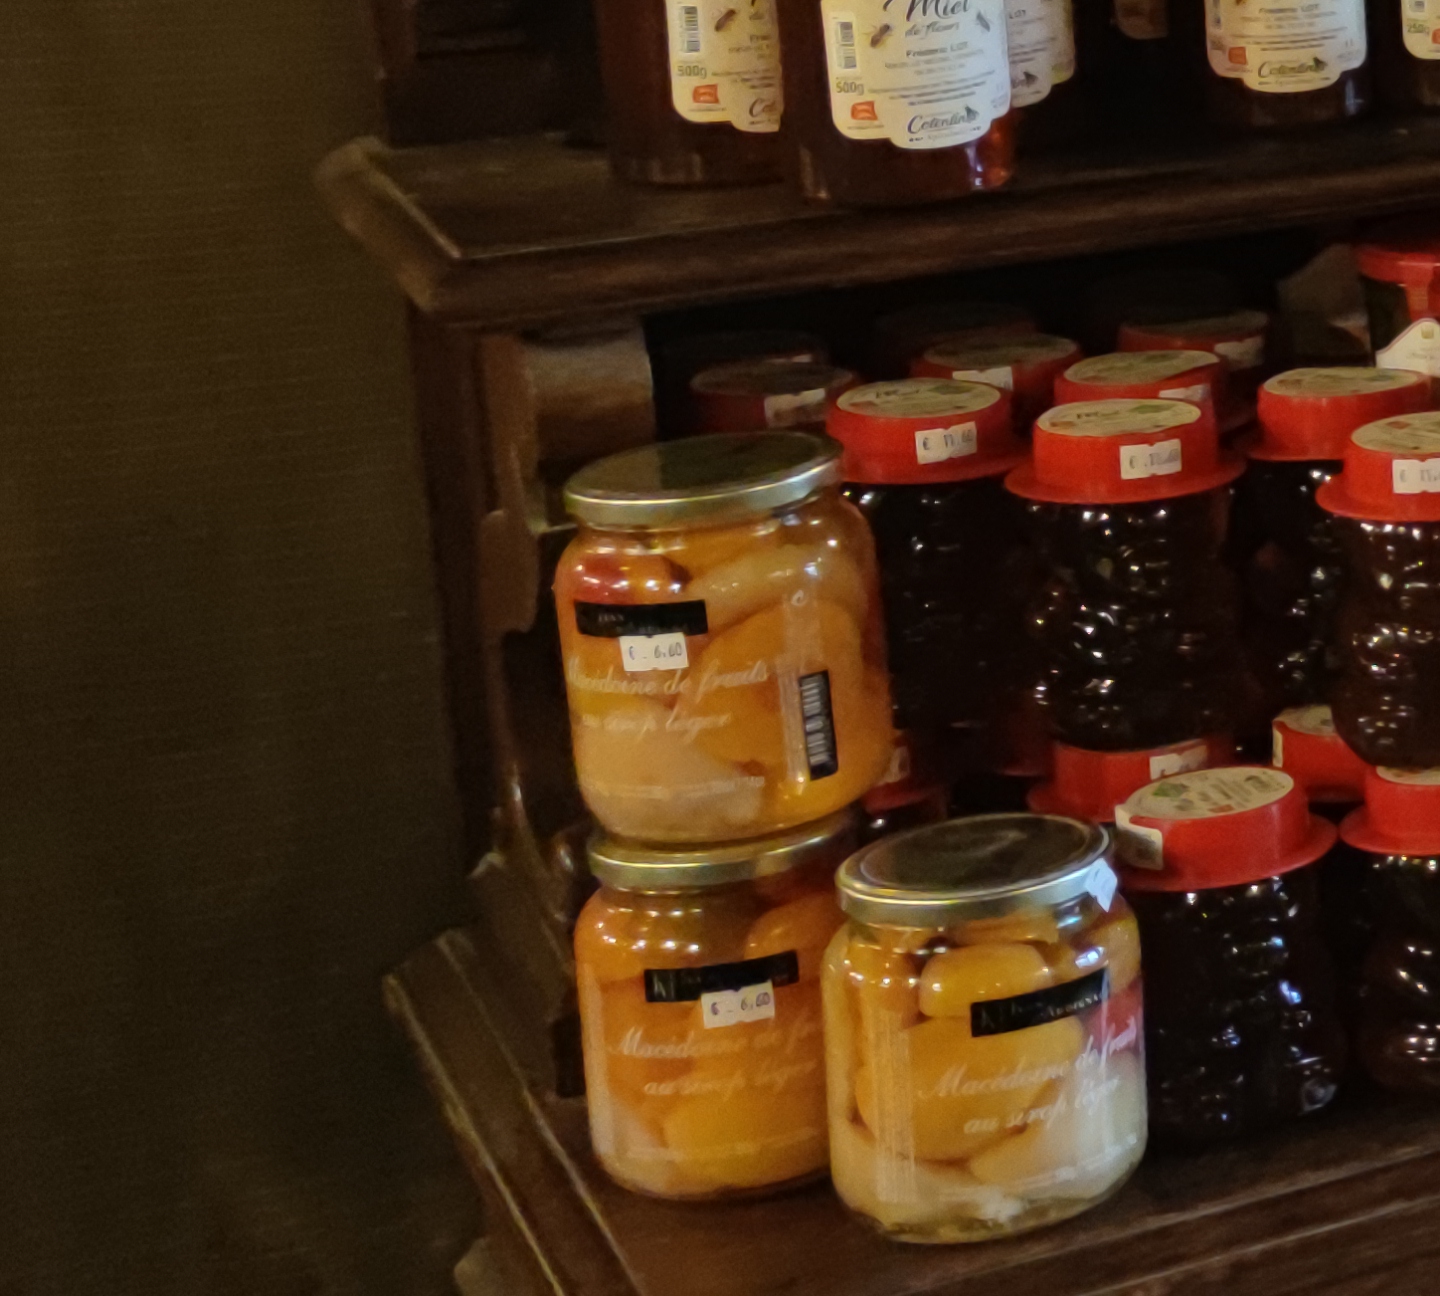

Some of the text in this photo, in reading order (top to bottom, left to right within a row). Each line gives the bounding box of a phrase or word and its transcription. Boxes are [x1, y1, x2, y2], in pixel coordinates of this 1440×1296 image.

[676, 64, 707, 79] 500g
[835, 80, 865, 95] 500g
[907, 112, 970, 136] Cotentin
[664, 668, 691, 694] de
[963, 1114, 998, 1134] au
